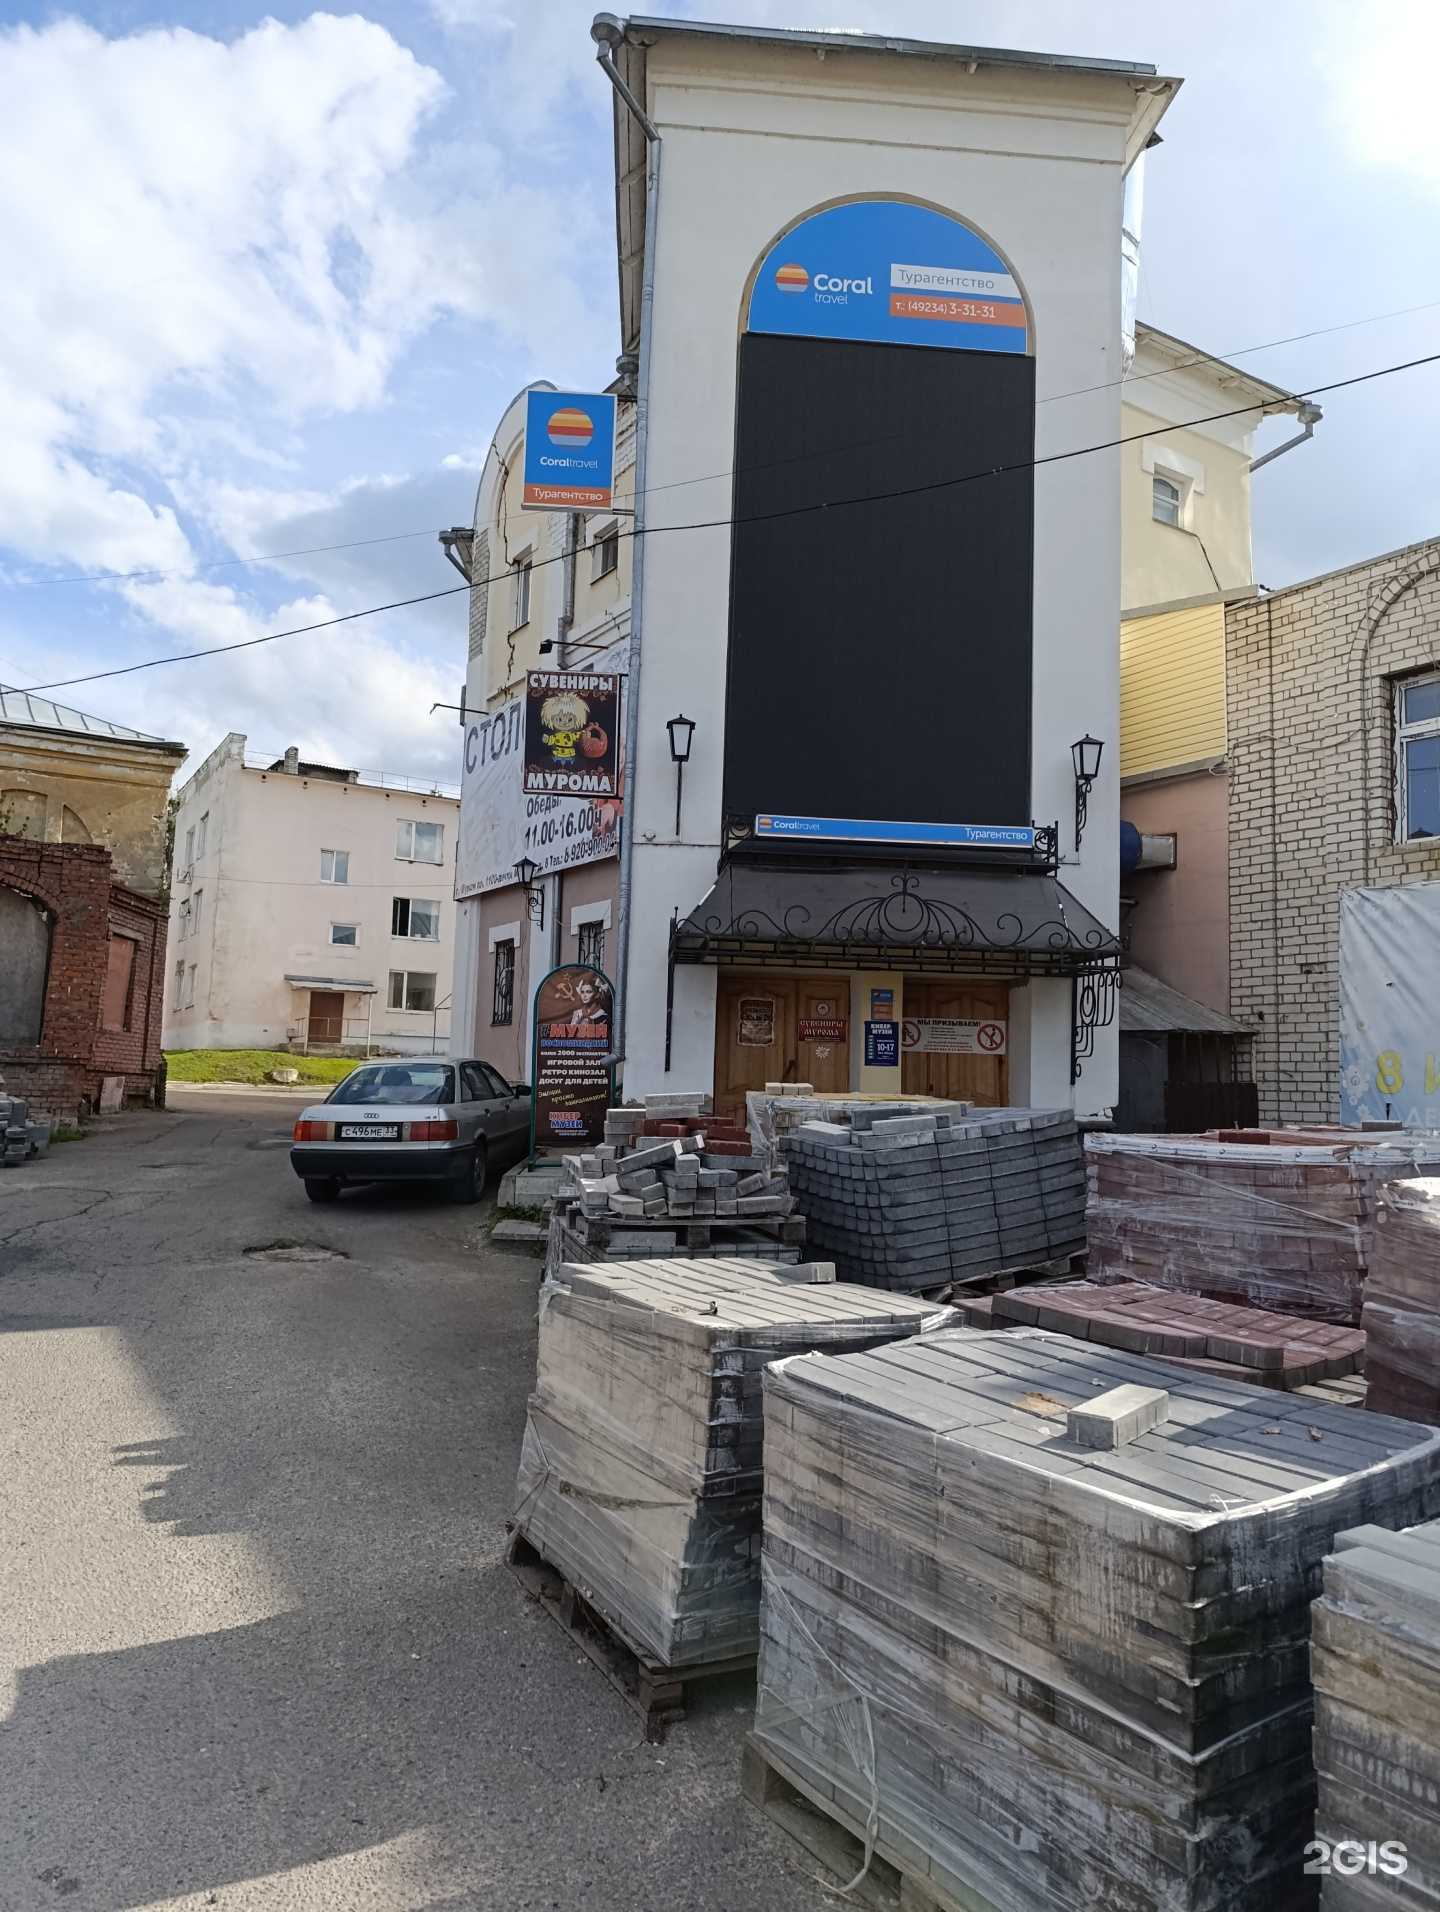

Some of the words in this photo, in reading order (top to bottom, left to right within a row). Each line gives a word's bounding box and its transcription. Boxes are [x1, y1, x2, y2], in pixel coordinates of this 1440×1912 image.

[813, 273, 873, 295] Coral
[898, 269, 995, 290] Турагентство
[814, 292, 849, 305] travel
[907, 301, 948, 315] (49234)
[949, 303, 997, 319] 3-31-31
[533, 487, 603, 501] Турагентство
[529, 673, 613, 691] СУВЕНИРЫ
[465, 700, 526, 774] СТОЛ
[527, 772, 612, 793] МУРОМА
[964, 827, 1028, 841] Турагентство
[547, 1058, 584, 1066] ИГРОВОЙ
[582, 1077, 609, 1085] ДЕТЕЙ
[1376, 1051, 1404, 1095] 8
